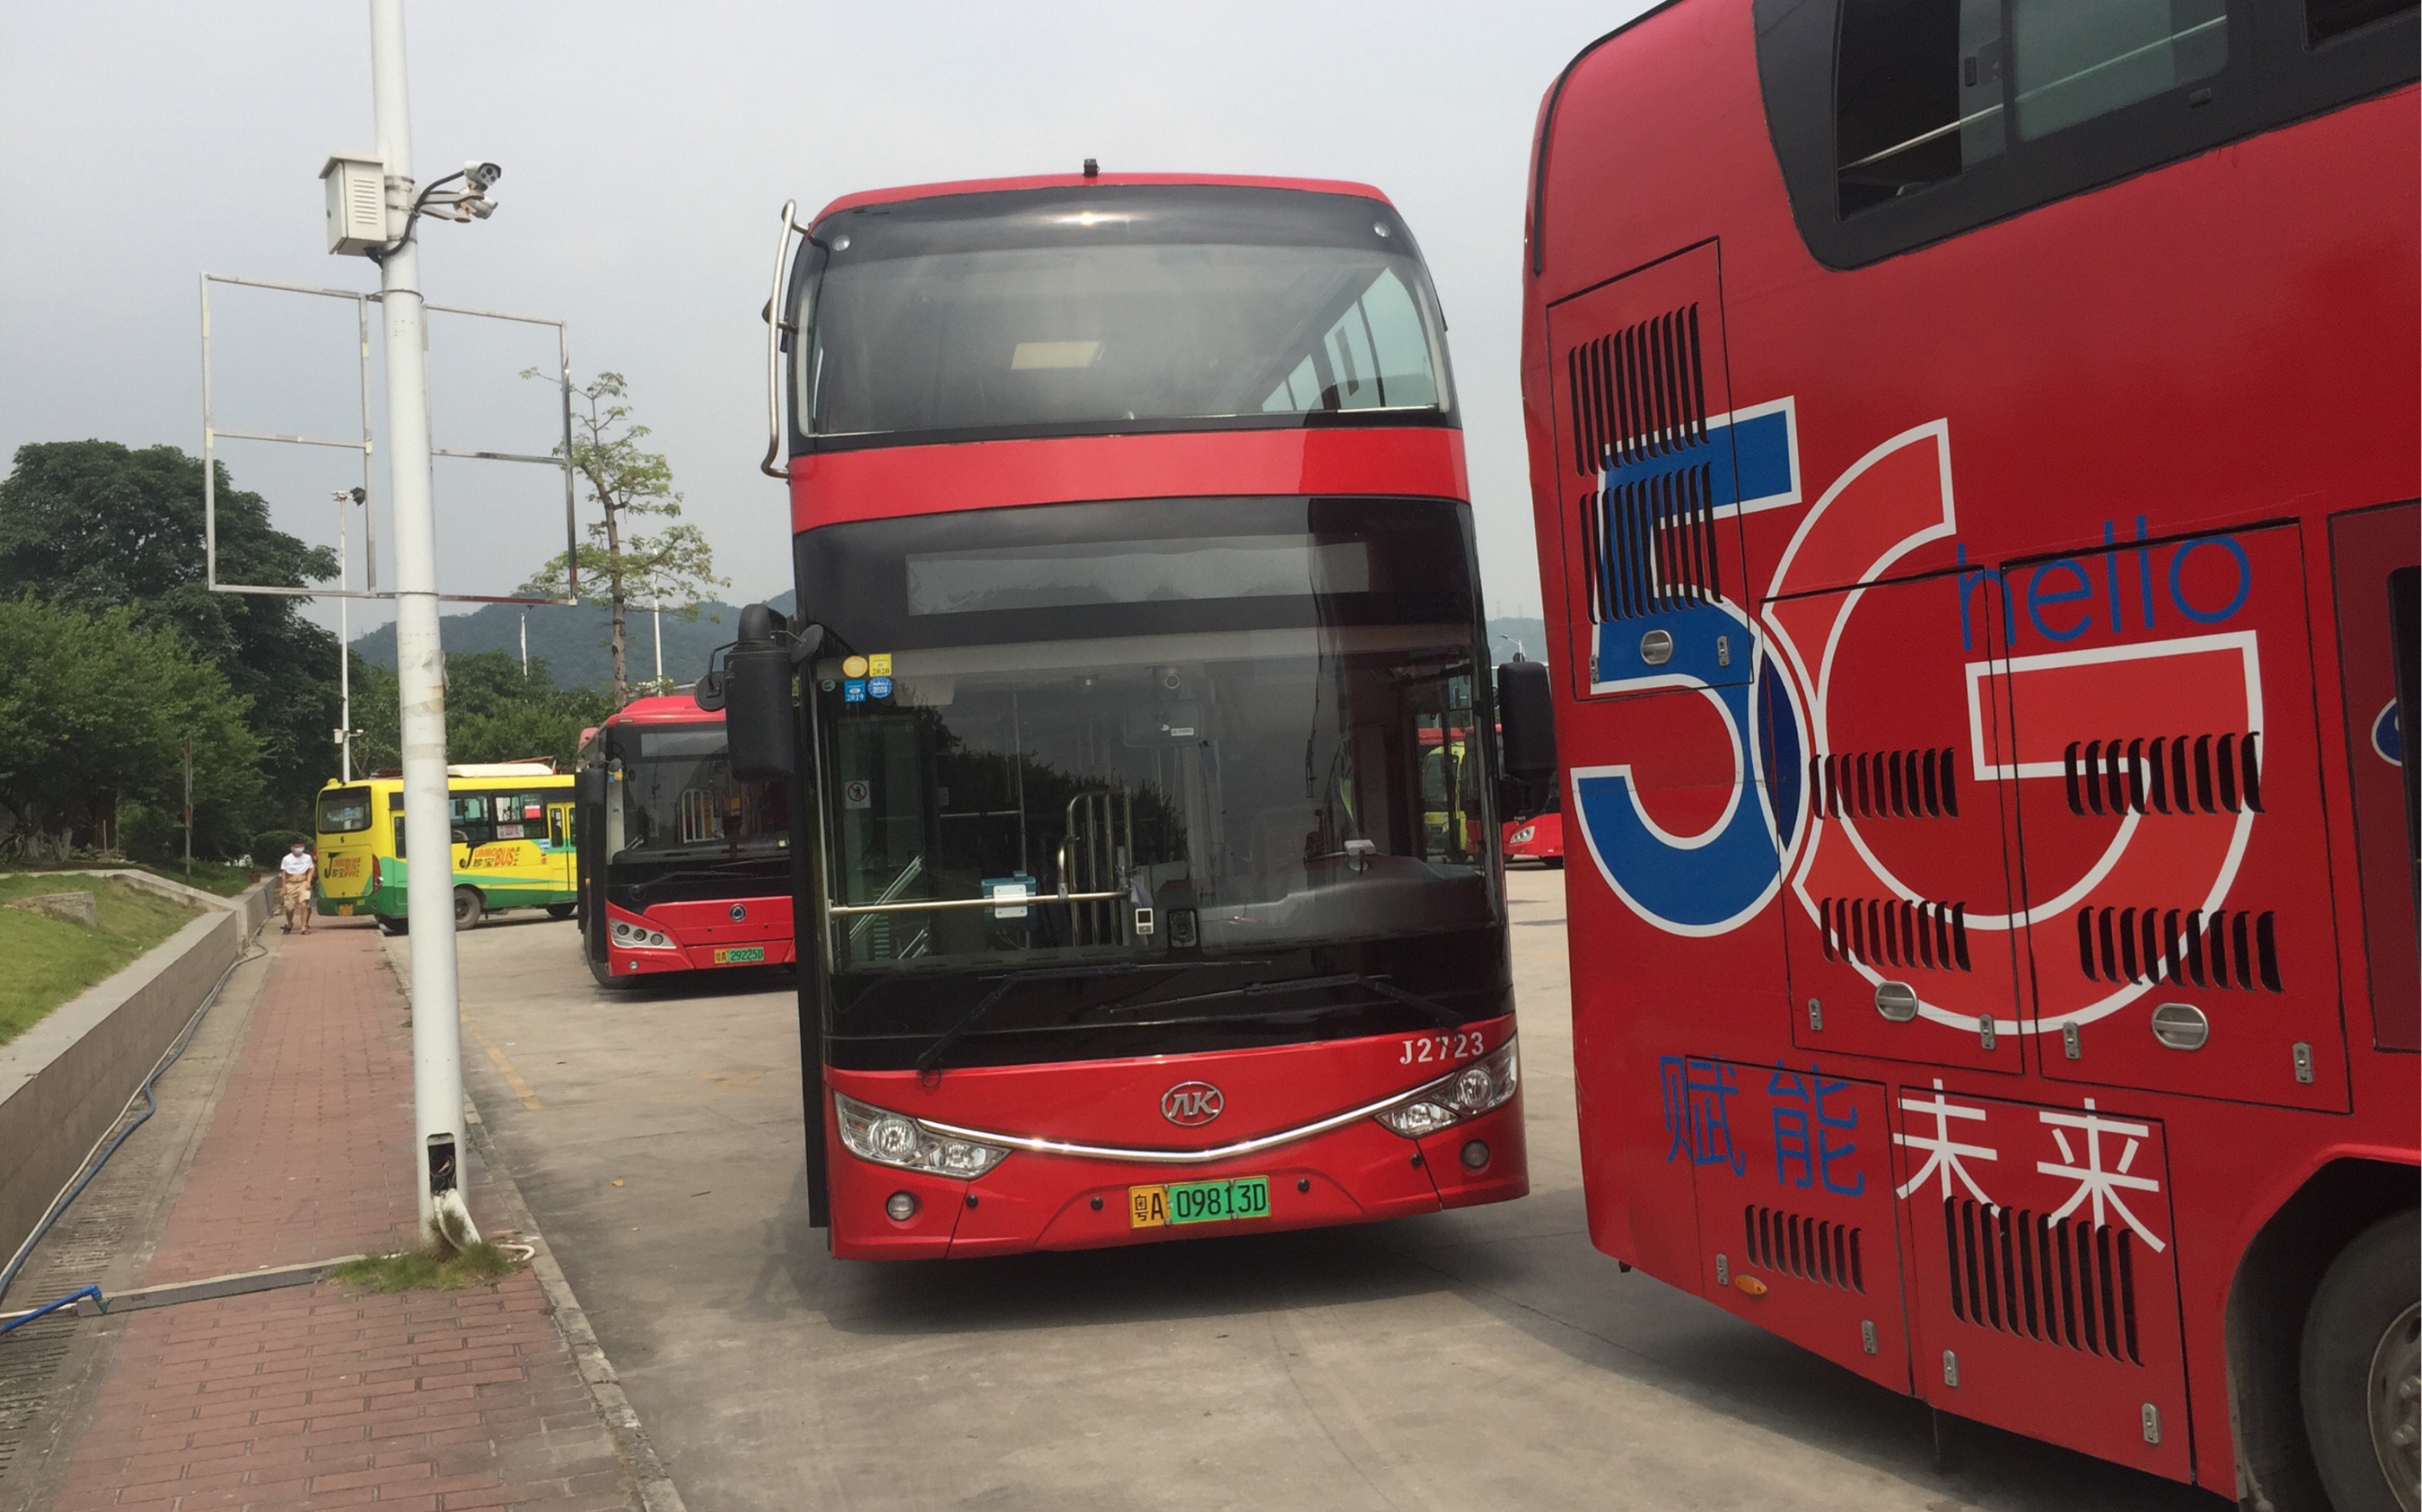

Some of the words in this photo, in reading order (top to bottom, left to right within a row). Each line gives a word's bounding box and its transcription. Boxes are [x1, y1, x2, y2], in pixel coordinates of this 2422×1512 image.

[1956, 514, 2252, 652] hello
[846, 693, 865, 701] 2019
[1570, 395, 2264, 1035] 5G
[493, 847, 516, 867] BUS
[1399, 1031, 1485, 1066] J2723
[1659, 1052, 2167, 1253] 赋能未来
